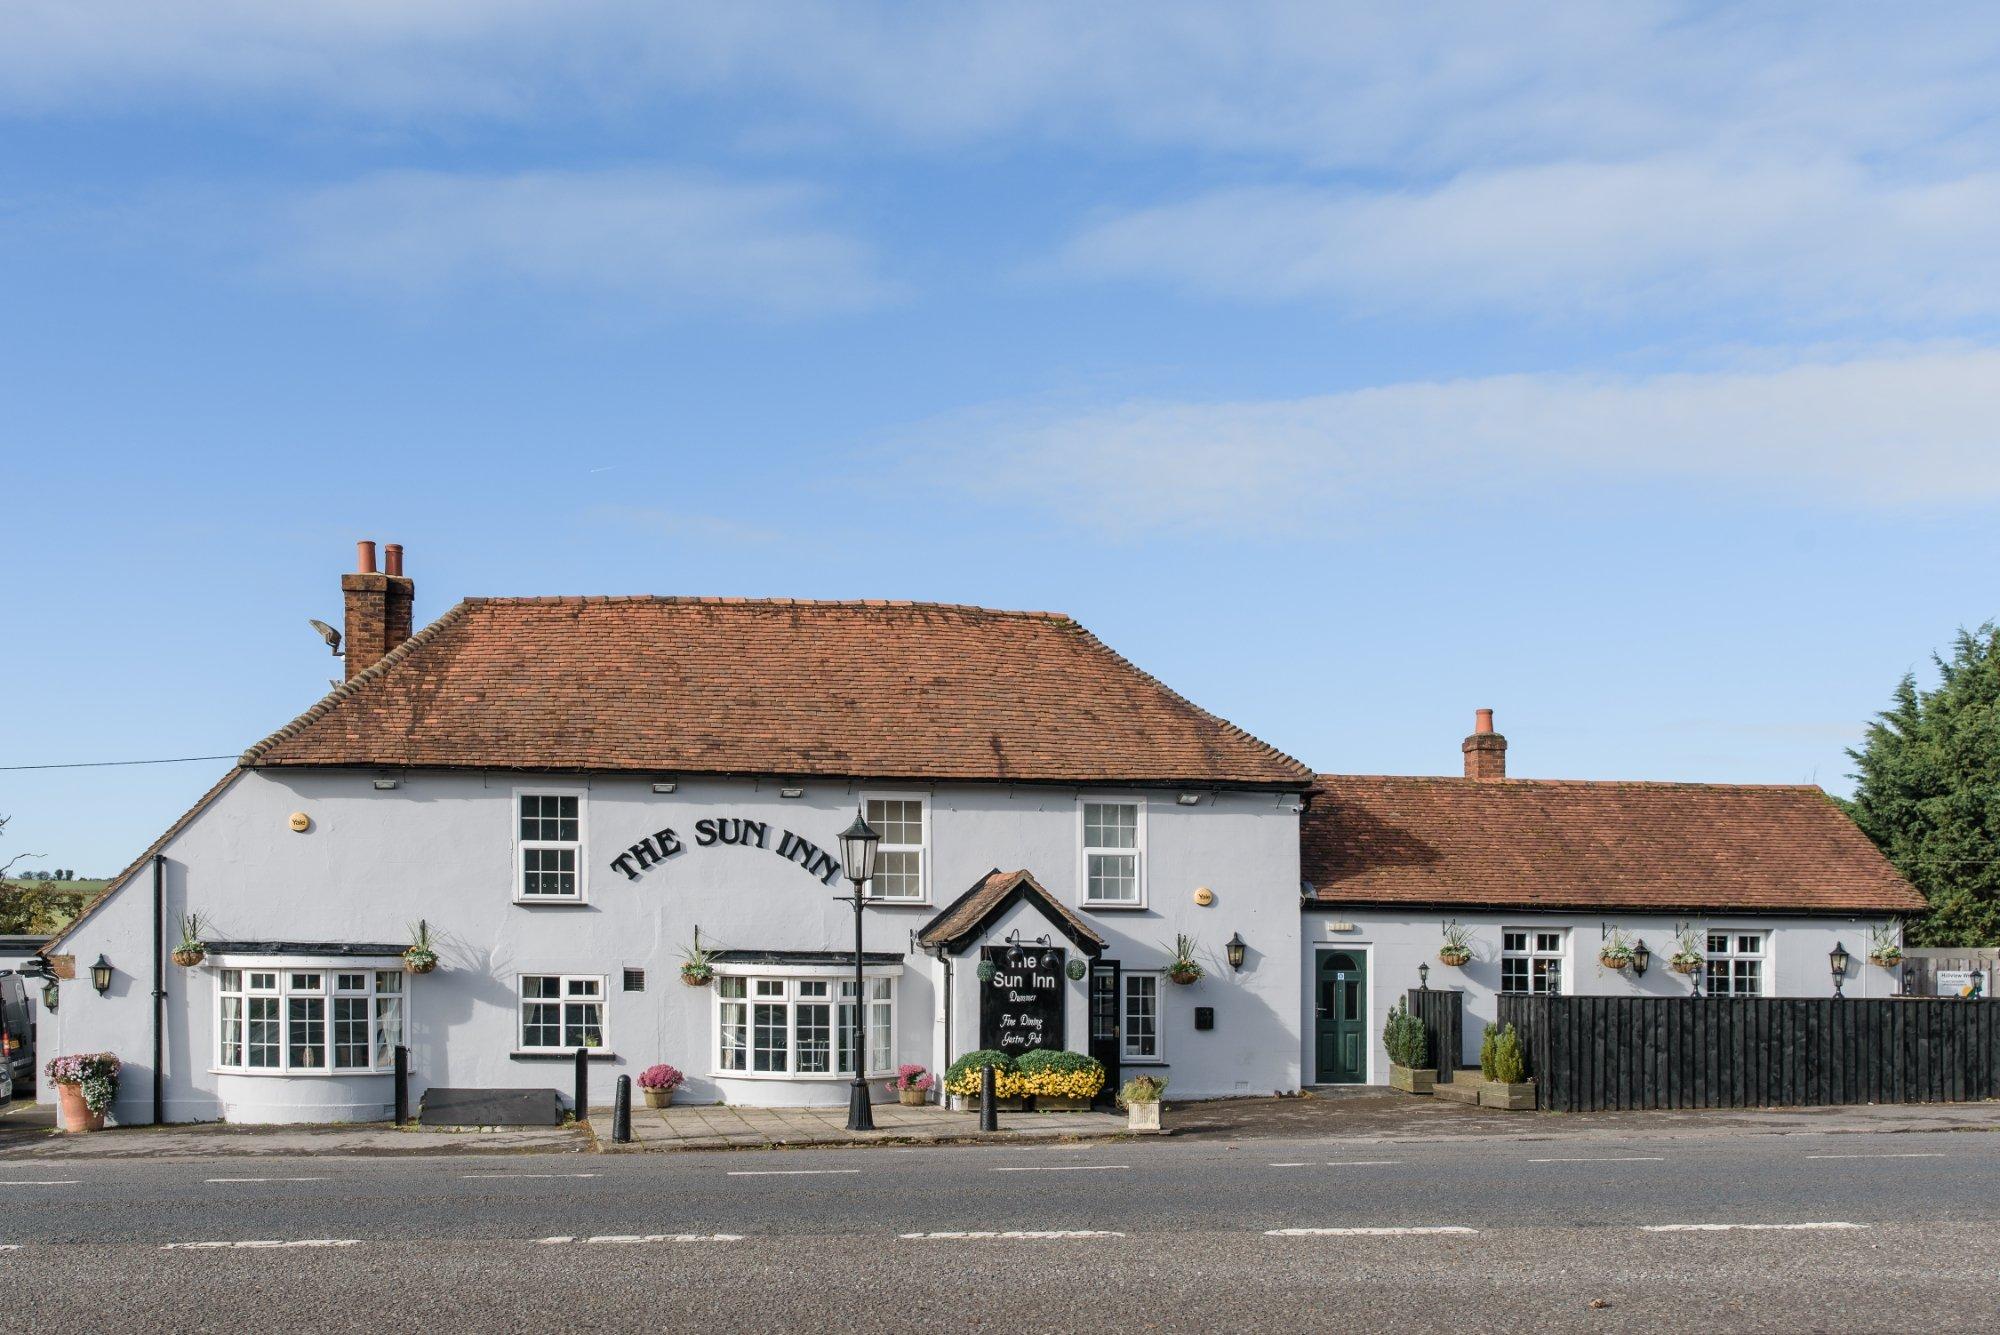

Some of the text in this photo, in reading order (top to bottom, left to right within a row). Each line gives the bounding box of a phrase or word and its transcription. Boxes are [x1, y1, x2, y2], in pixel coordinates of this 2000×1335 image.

[610, 818, 840, 886] THE SUN INN
[993, 971, 1055, 989] Sun Inn
[1000, 1013, 1043, 1030] Fine Dining
[1024, 1032, 1042, 1047] Pub
